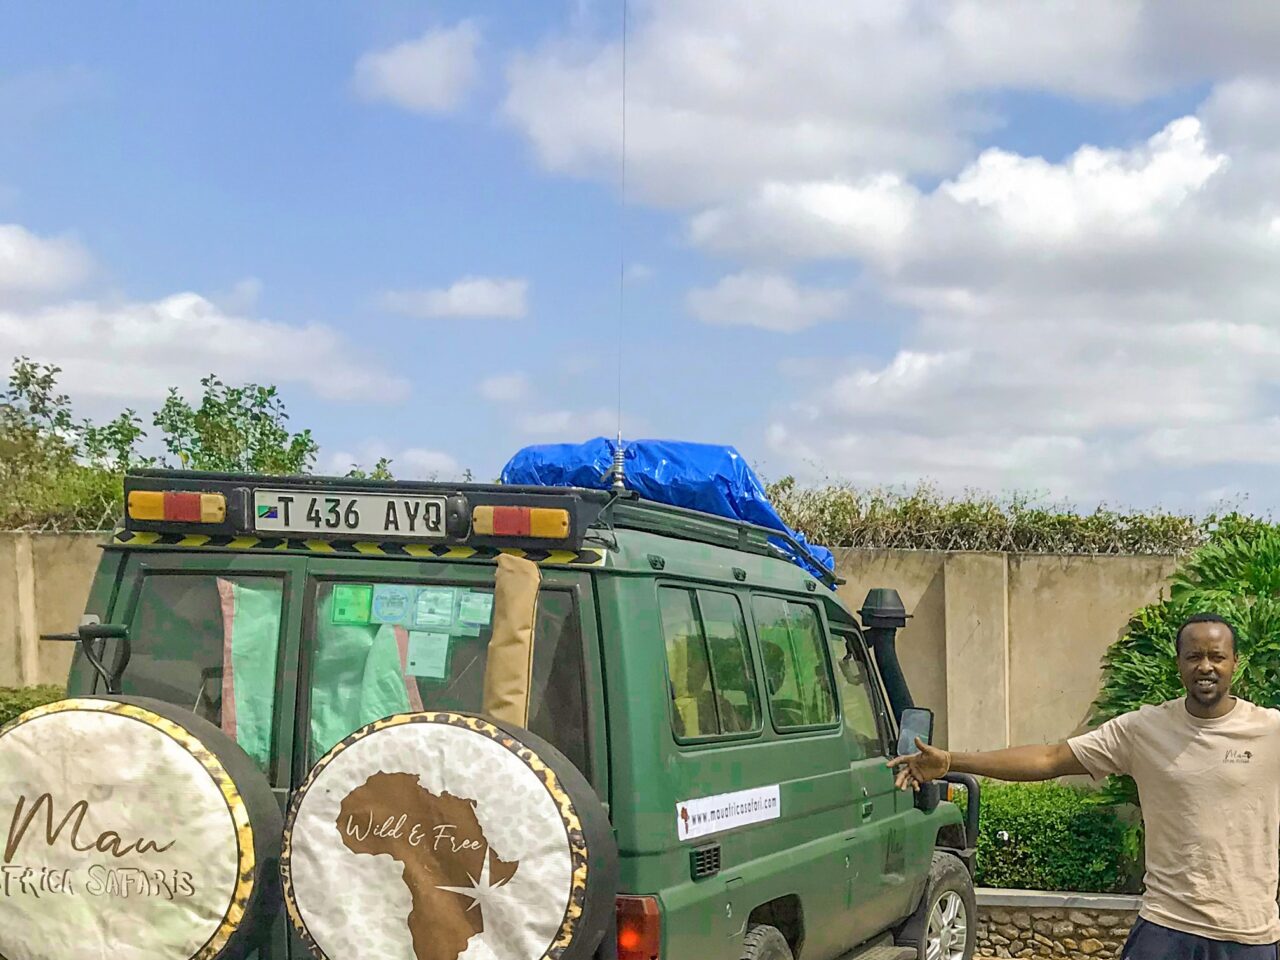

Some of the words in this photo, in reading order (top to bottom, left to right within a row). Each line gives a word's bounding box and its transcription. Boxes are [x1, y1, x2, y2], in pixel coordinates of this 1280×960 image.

[278, 496, 294, 527] T
[306, 497, 360, 529] 436
[384, 500, 441, 532] AYQ
[4, 792, 176, 864] Mau
[691, 797, 777, 825] www.mauafricasafari.com
[346, 809, 404, 842] Wild
[408, 823, 426, 846] &
[433, 824, 482, 853] Free
[0, 865, 74, 899] FRICA
